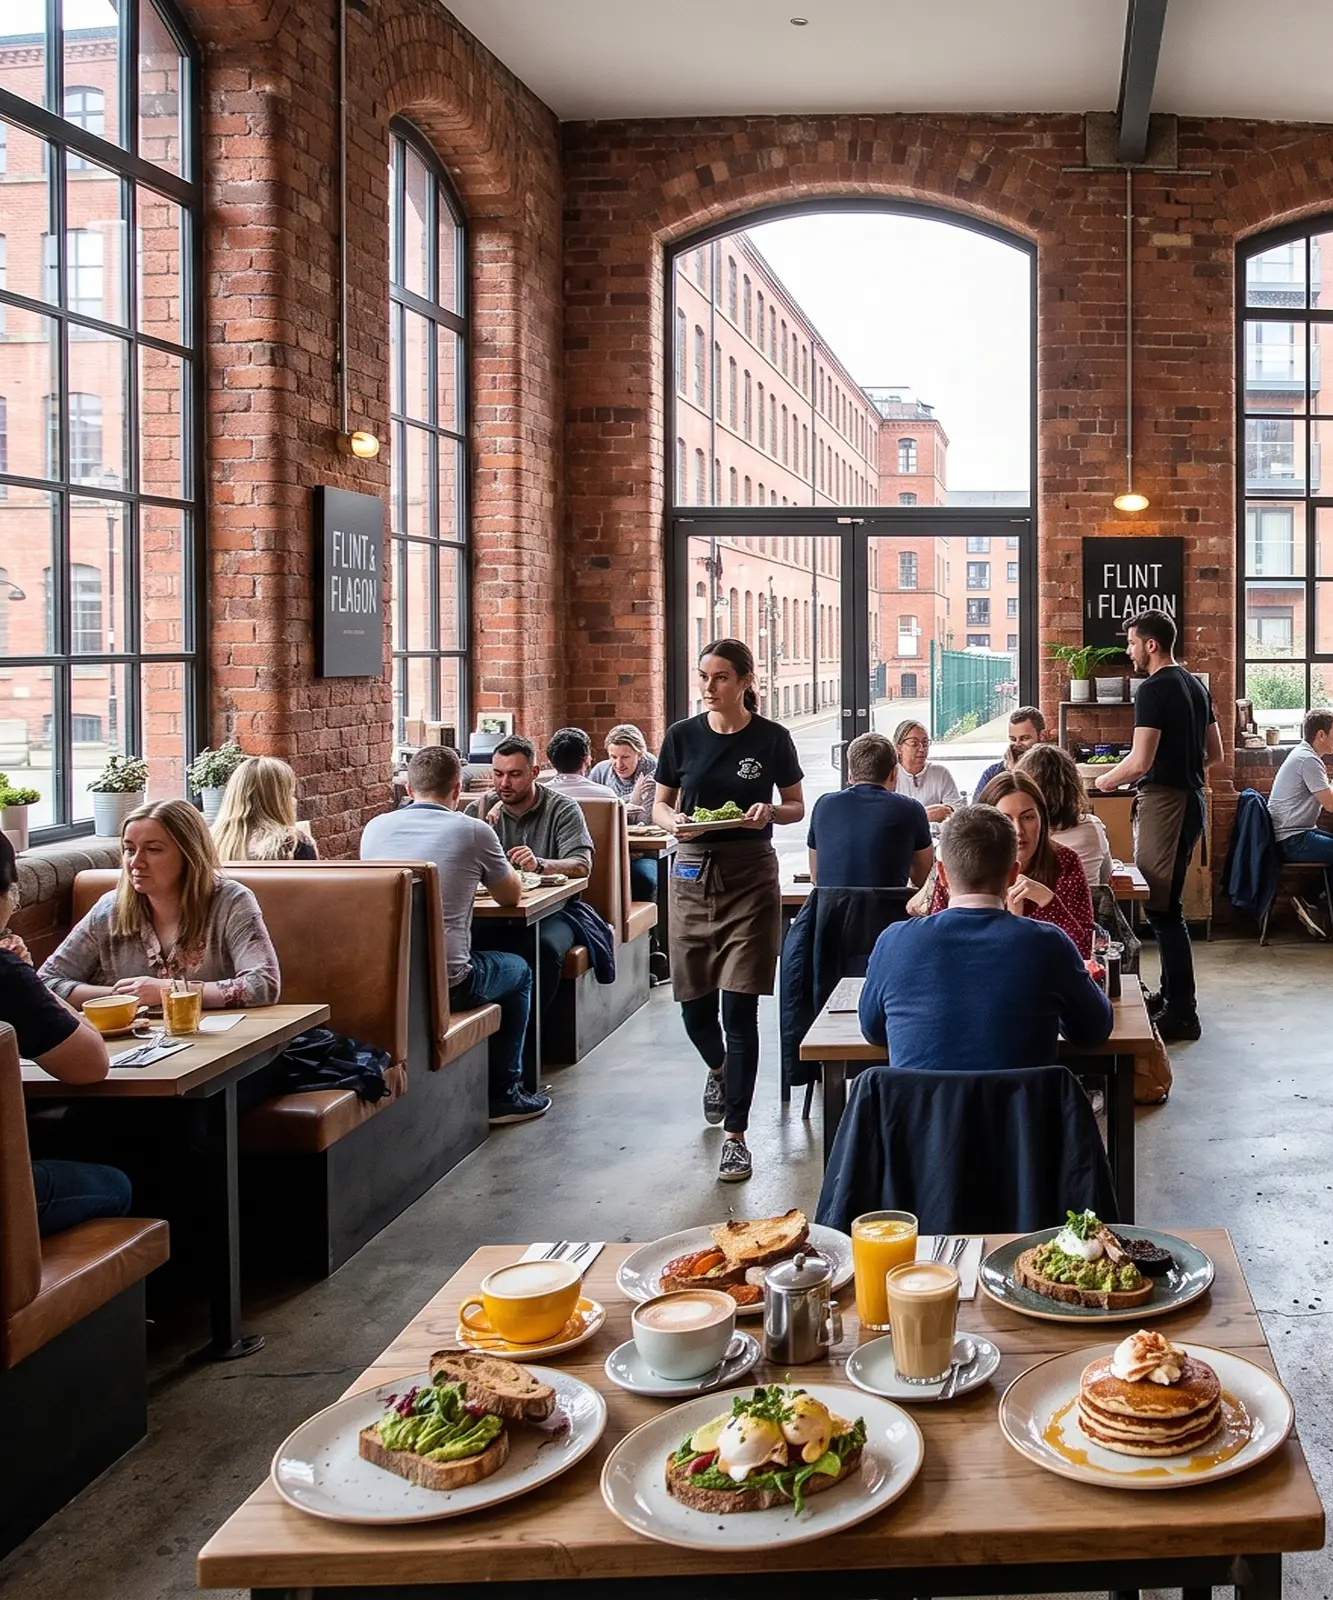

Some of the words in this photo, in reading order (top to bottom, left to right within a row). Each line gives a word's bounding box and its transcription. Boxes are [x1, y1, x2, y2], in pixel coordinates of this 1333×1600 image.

[332, 530, 369, 571] FLINT
[1103, 563, 1163, 589] FLINT
[331, 575, 377, 614] FLAGON
[1098, 594, 1177, 619] FLAGON
